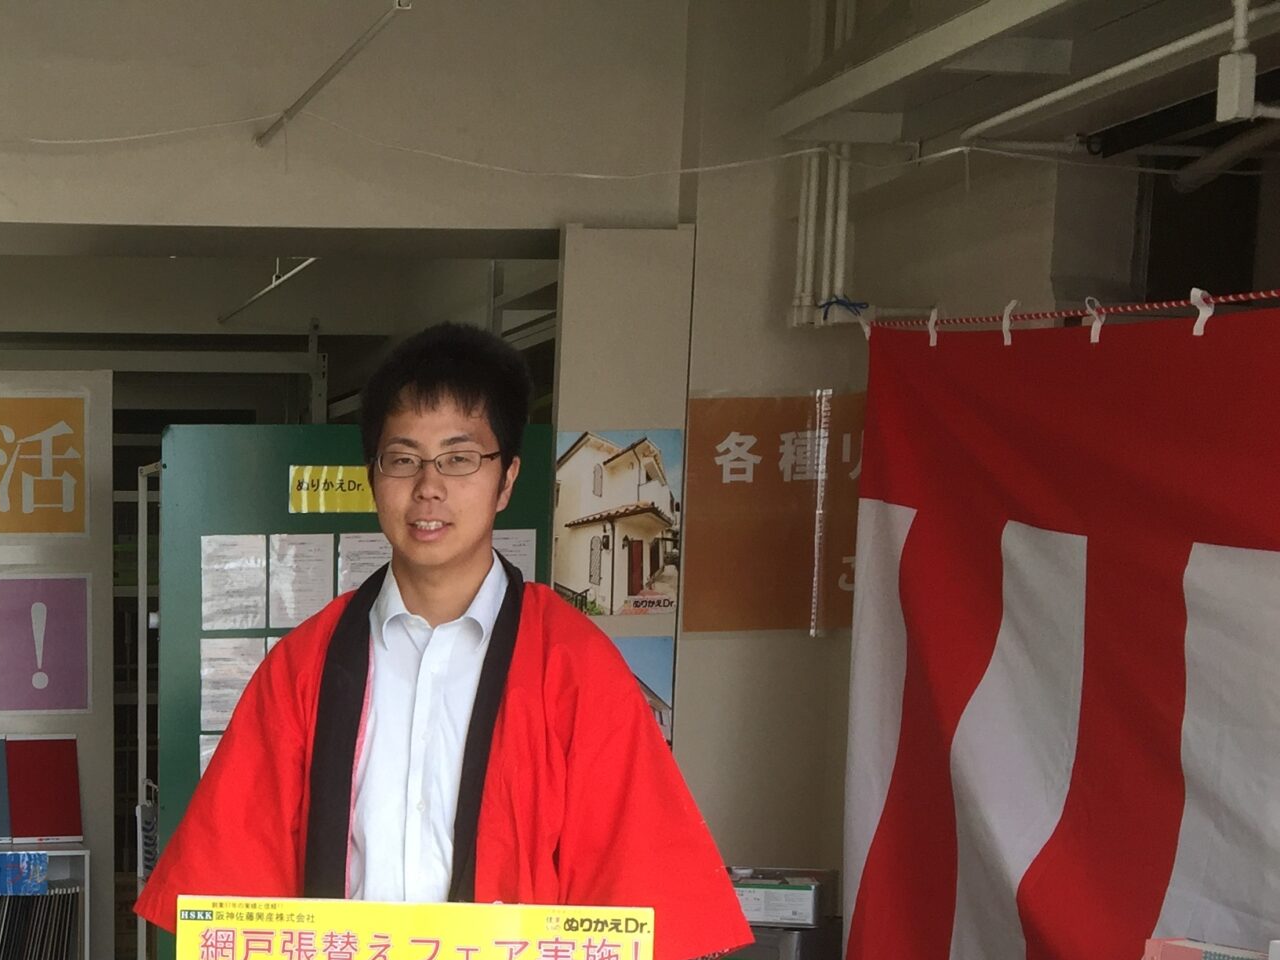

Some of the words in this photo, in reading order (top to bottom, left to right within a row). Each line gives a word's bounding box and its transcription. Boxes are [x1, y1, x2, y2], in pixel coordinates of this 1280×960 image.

[295, 479, 365, 492] ぬりかえDr.
[181, 911, 213, 920] HSKK
[215, 911, 315, 923] 阪神佐藤興産株式会社
[563, 917, 651, 934] ぬりかえDr.
